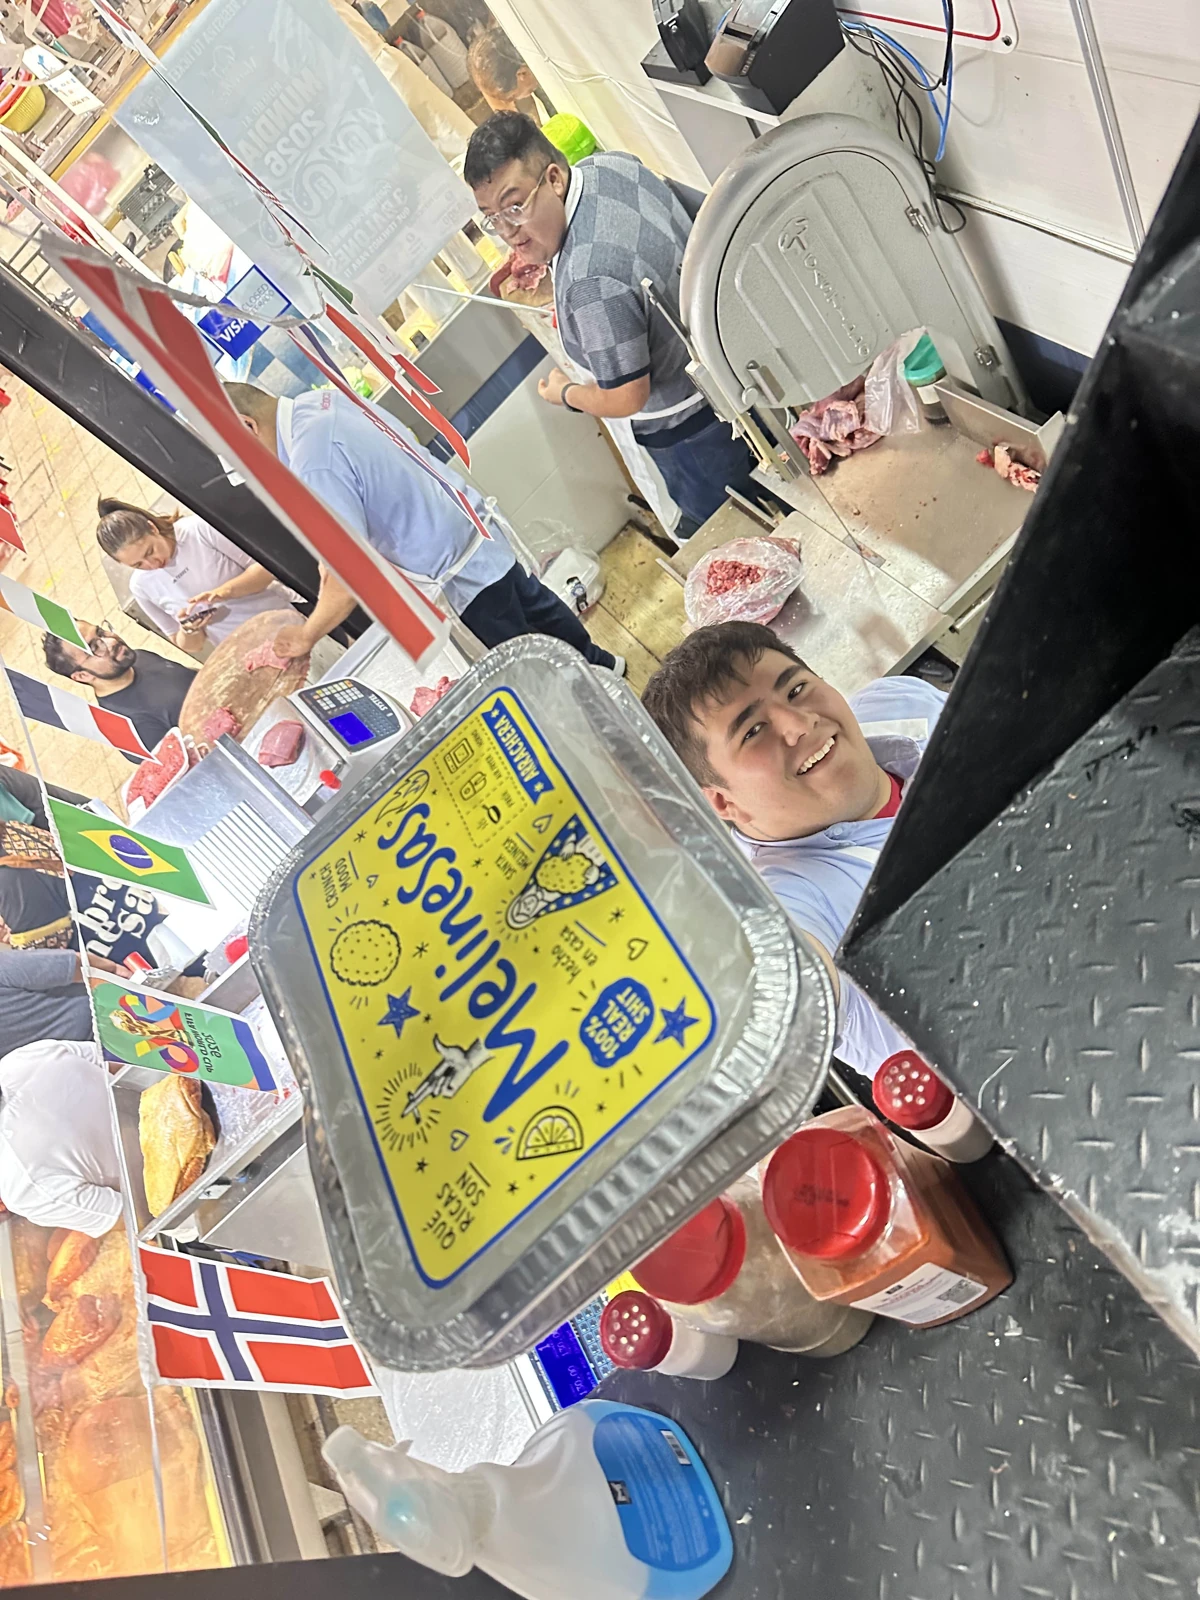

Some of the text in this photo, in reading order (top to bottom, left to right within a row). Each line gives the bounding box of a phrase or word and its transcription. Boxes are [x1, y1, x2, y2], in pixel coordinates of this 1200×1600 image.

[240, 282, 270, 311] CLOSED
[219, 314, 248, 341] VISA
[368, 693, 388, 711] SYSTEL
[491, 714, 540, 783] ARRACHERA
[318, 862, 338, 909] CRUNCH
[334, 856, 351, 892] MOOD
[493, 853, 517, 879] SANTA
[378, 803, 570, 1123] Melinesas
[545, 943, 582, 984] hecho
[557, 924, 599, 967] en casa
[599, 998, 636, 1043] REAL
[615, 985, 651, 1025] SHIT
[581, 1014, 621, 1061] 100%
[435, 1180, 475, 1231] RICAS
[453, 1169, 486, 1206] SON
[420, 1210, 459, 1249] QUÉ
